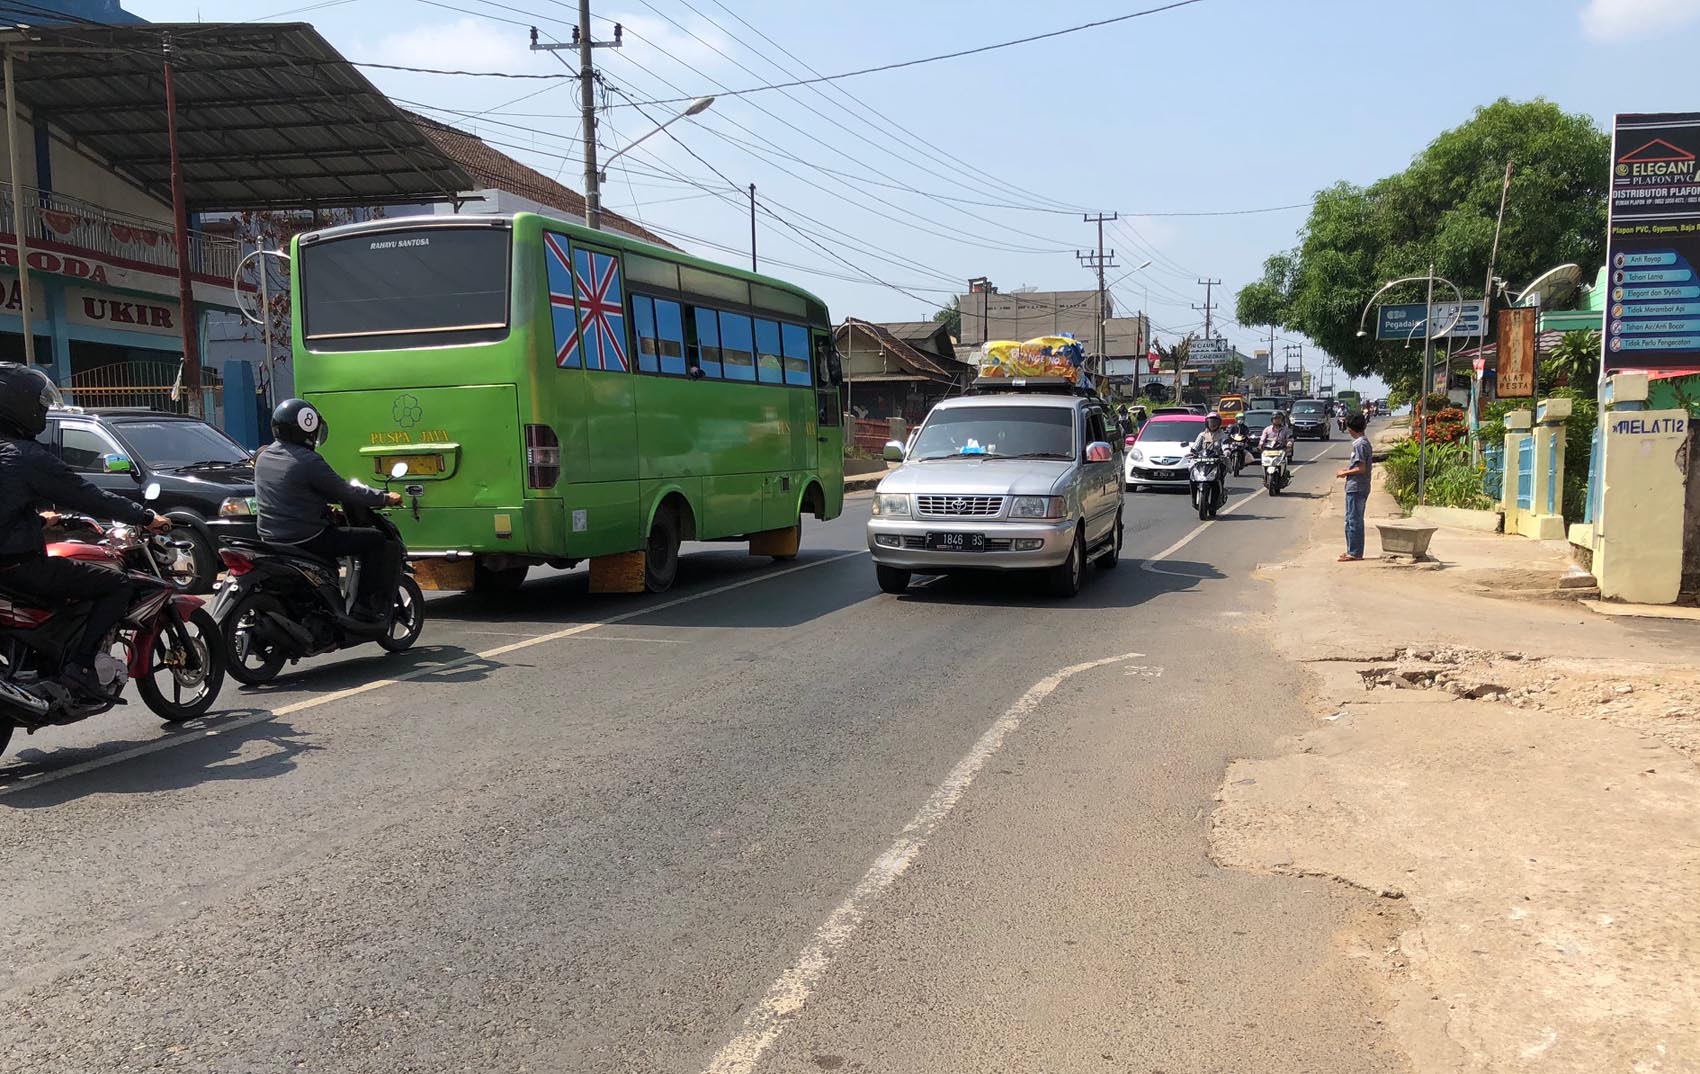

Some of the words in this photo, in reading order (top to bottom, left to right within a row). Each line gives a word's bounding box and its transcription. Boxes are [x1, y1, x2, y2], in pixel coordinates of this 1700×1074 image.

[1633, 161, 1695, 175] ELEGANT
[1633, 176, 1672, 184] PLAFON
[1674, 174, 1694, 183] PVC
[1612, 189, 1667, 198] DISTRIBUTOR
[370, 241, 397, 250] RAHAYU
[397, 238, 430, 248] SANTOSA
[82, 297, 174, 328] UKIR
[1499, 382, 1529, 390] PESTA
[304, 412, 314, 427] 8
[370, 431, 411, 445] PUSPA
[926, 533, 933, 544] F
[943, 533, 964, 545] 1846
